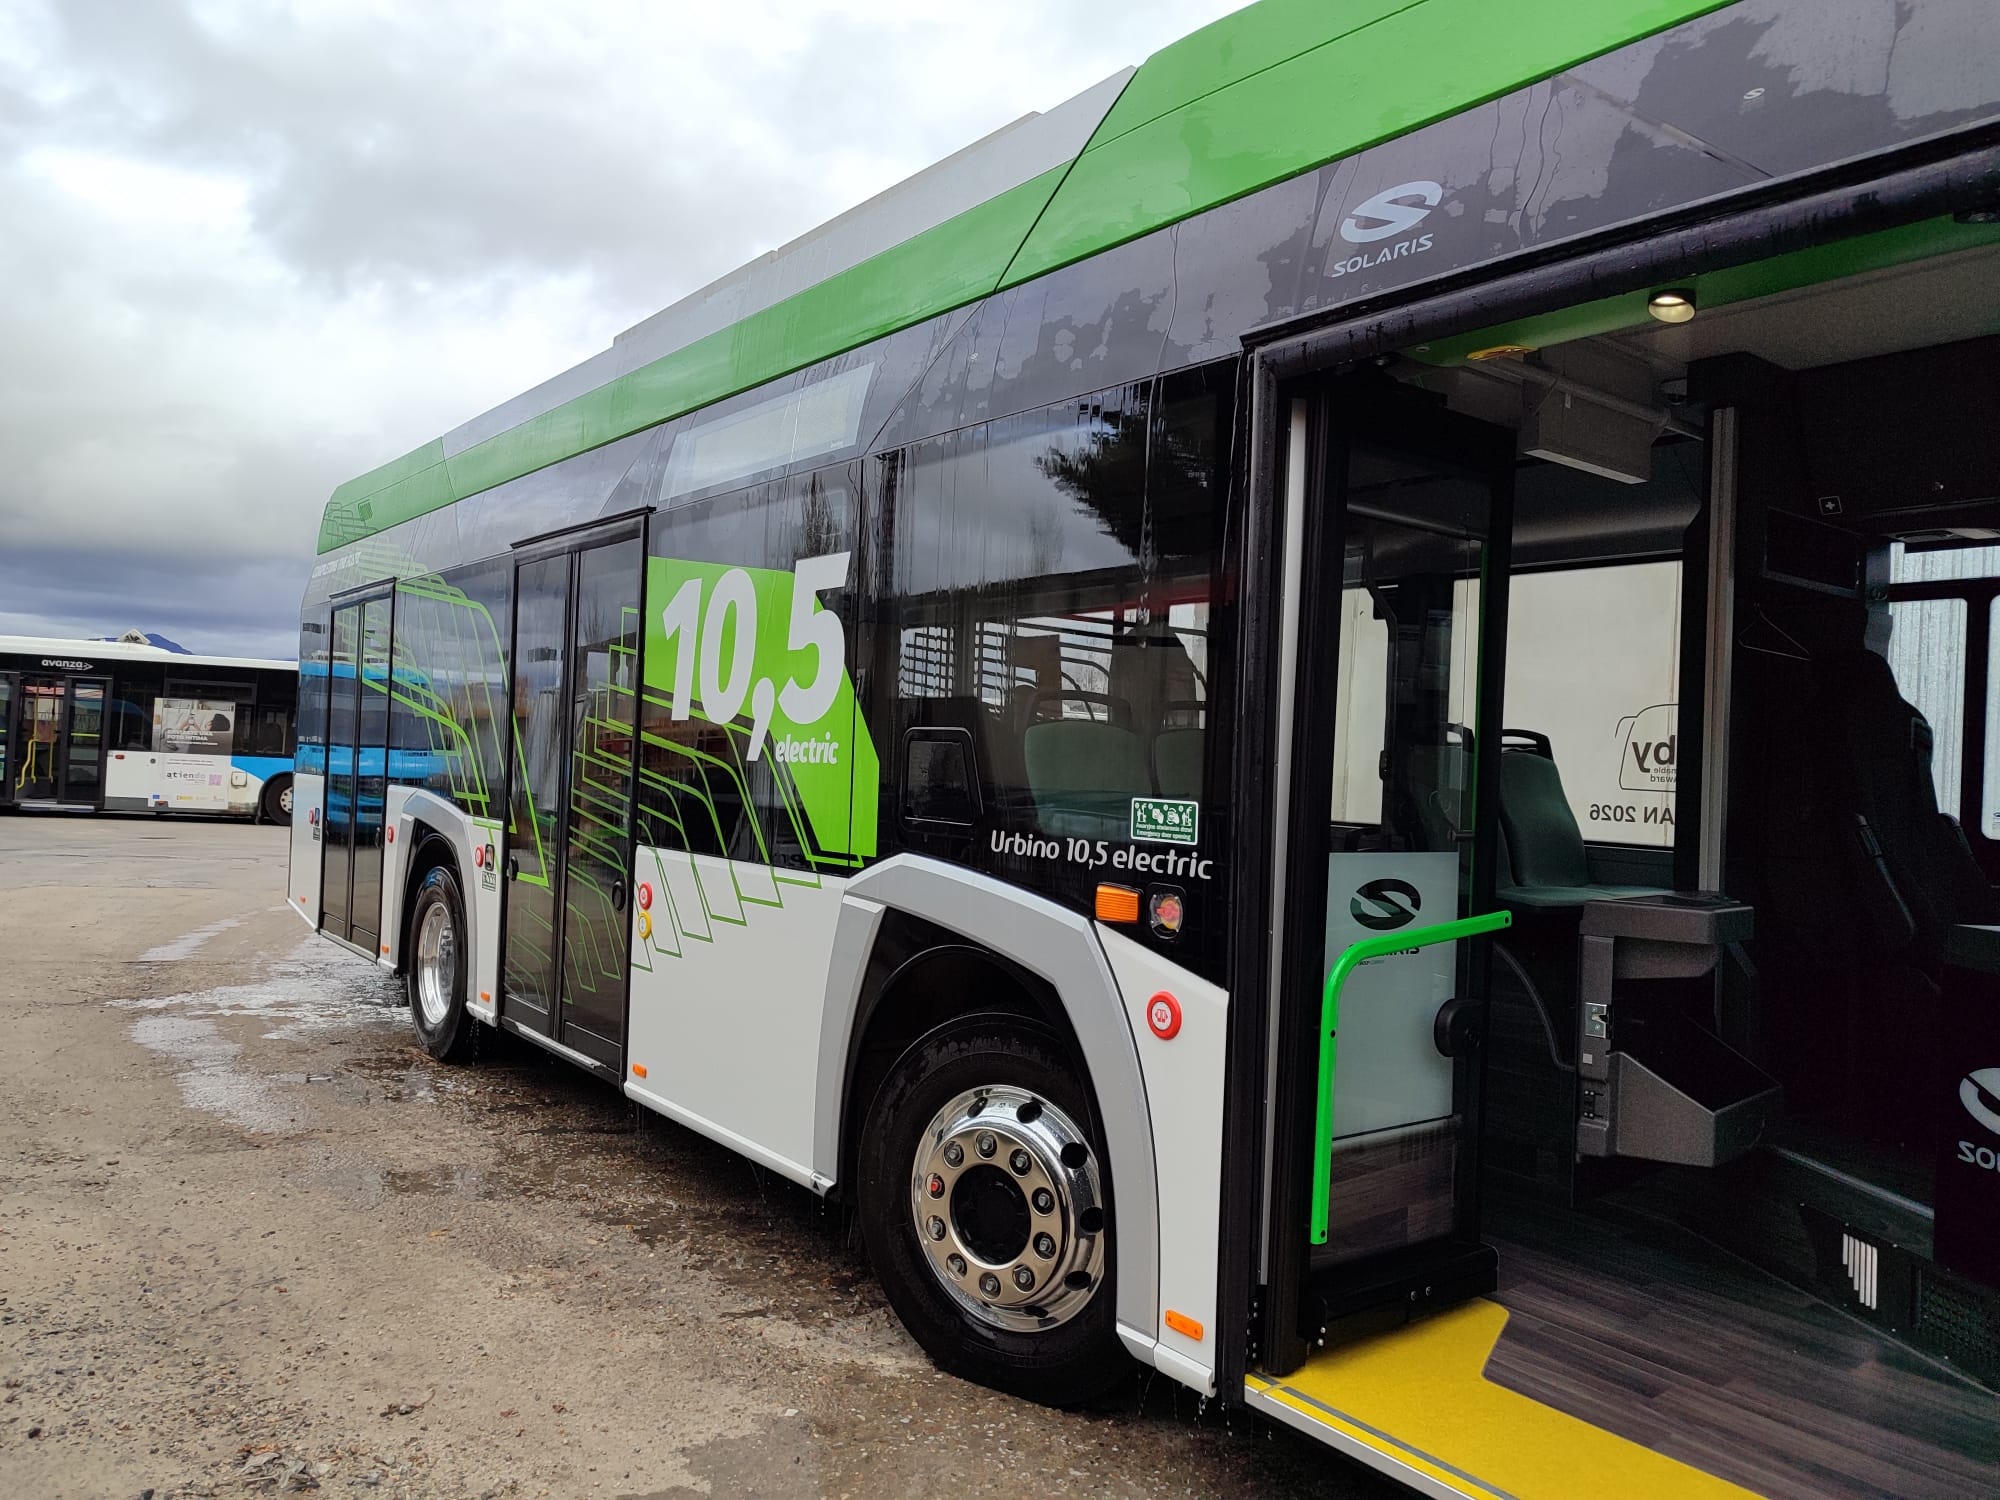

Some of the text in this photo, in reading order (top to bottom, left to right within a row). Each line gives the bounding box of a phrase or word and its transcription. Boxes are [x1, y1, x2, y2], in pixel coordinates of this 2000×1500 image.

[1331, 233, 1434, 278] SOLARIS
[41, 659, 83, 668] avanza
[662, 551, 852, 762] 10,5
[775, 731, 839, 765] electric
[990, 829, 1214, 880] Urbino 10,5 electric
